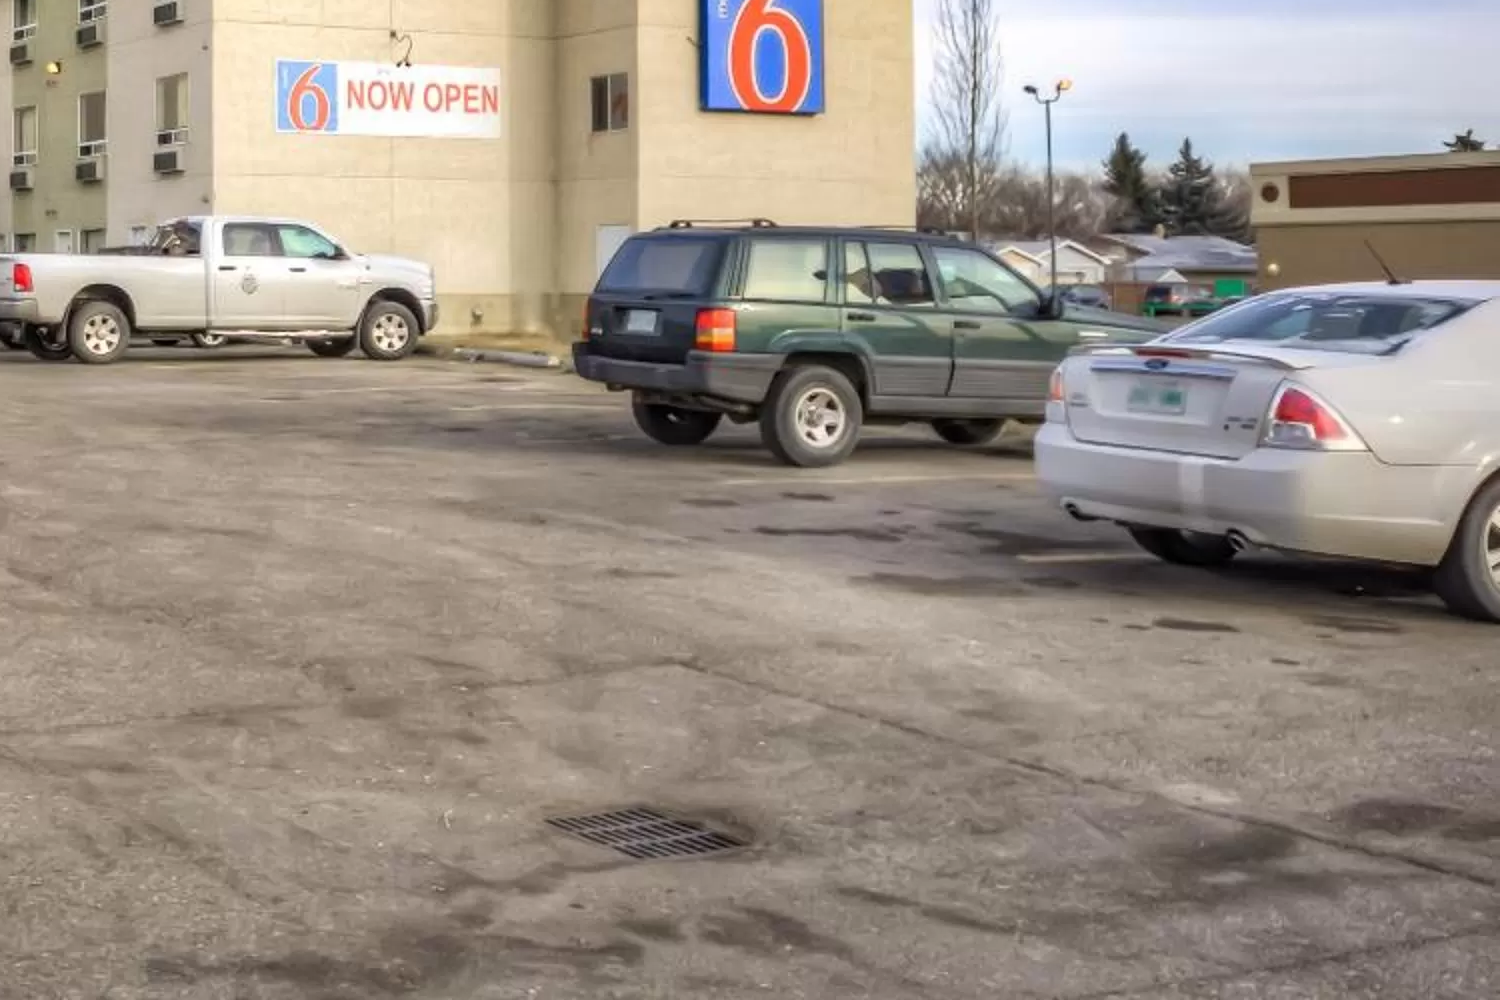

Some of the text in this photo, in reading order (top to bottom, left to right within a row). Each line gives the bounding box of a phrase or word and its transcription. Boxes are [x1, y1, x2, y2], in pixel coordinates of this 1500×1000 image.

[288, 64, 329, 130] 6
[347, 80, 498, 113] NOW OPEN
